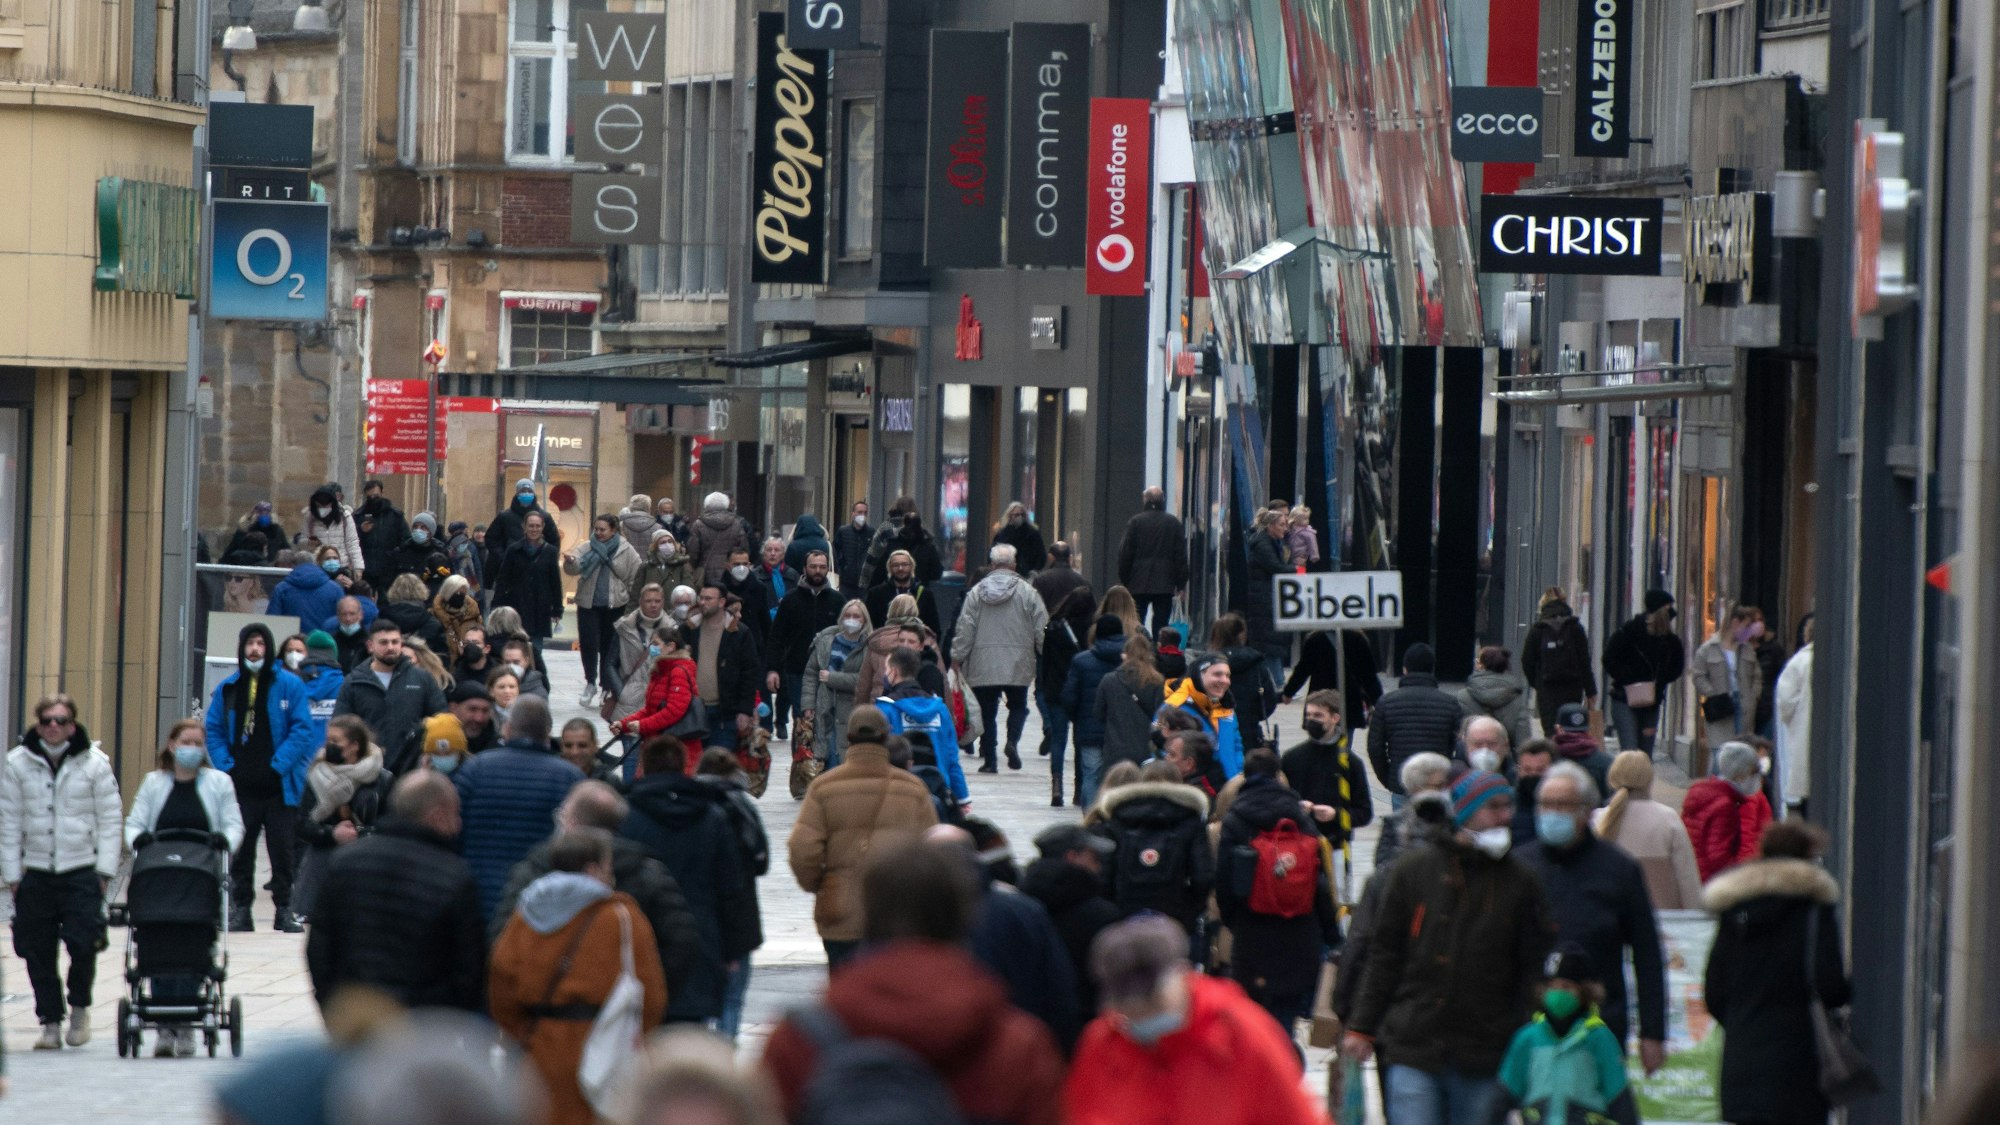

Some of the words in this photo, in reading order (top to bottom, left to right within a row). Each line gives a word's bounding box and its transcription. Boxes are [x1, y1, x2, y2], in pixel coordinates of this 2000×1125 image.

[1036, 51, 1069, 237] comma,
[1457, 113, 1538, 135] ecco
[756, 33, 823, 263] Pieper
[947, 95, 988, 207] s.Oliver
[1106, 123, 1128, 229] vodafone
[1492, 214, 1651, 256] CHRIST
[518, 298, 582, 313] WEMPE
[515, 435, 583, 449] WEMPE
[1278, 575, 1399, 619] Bibeln
